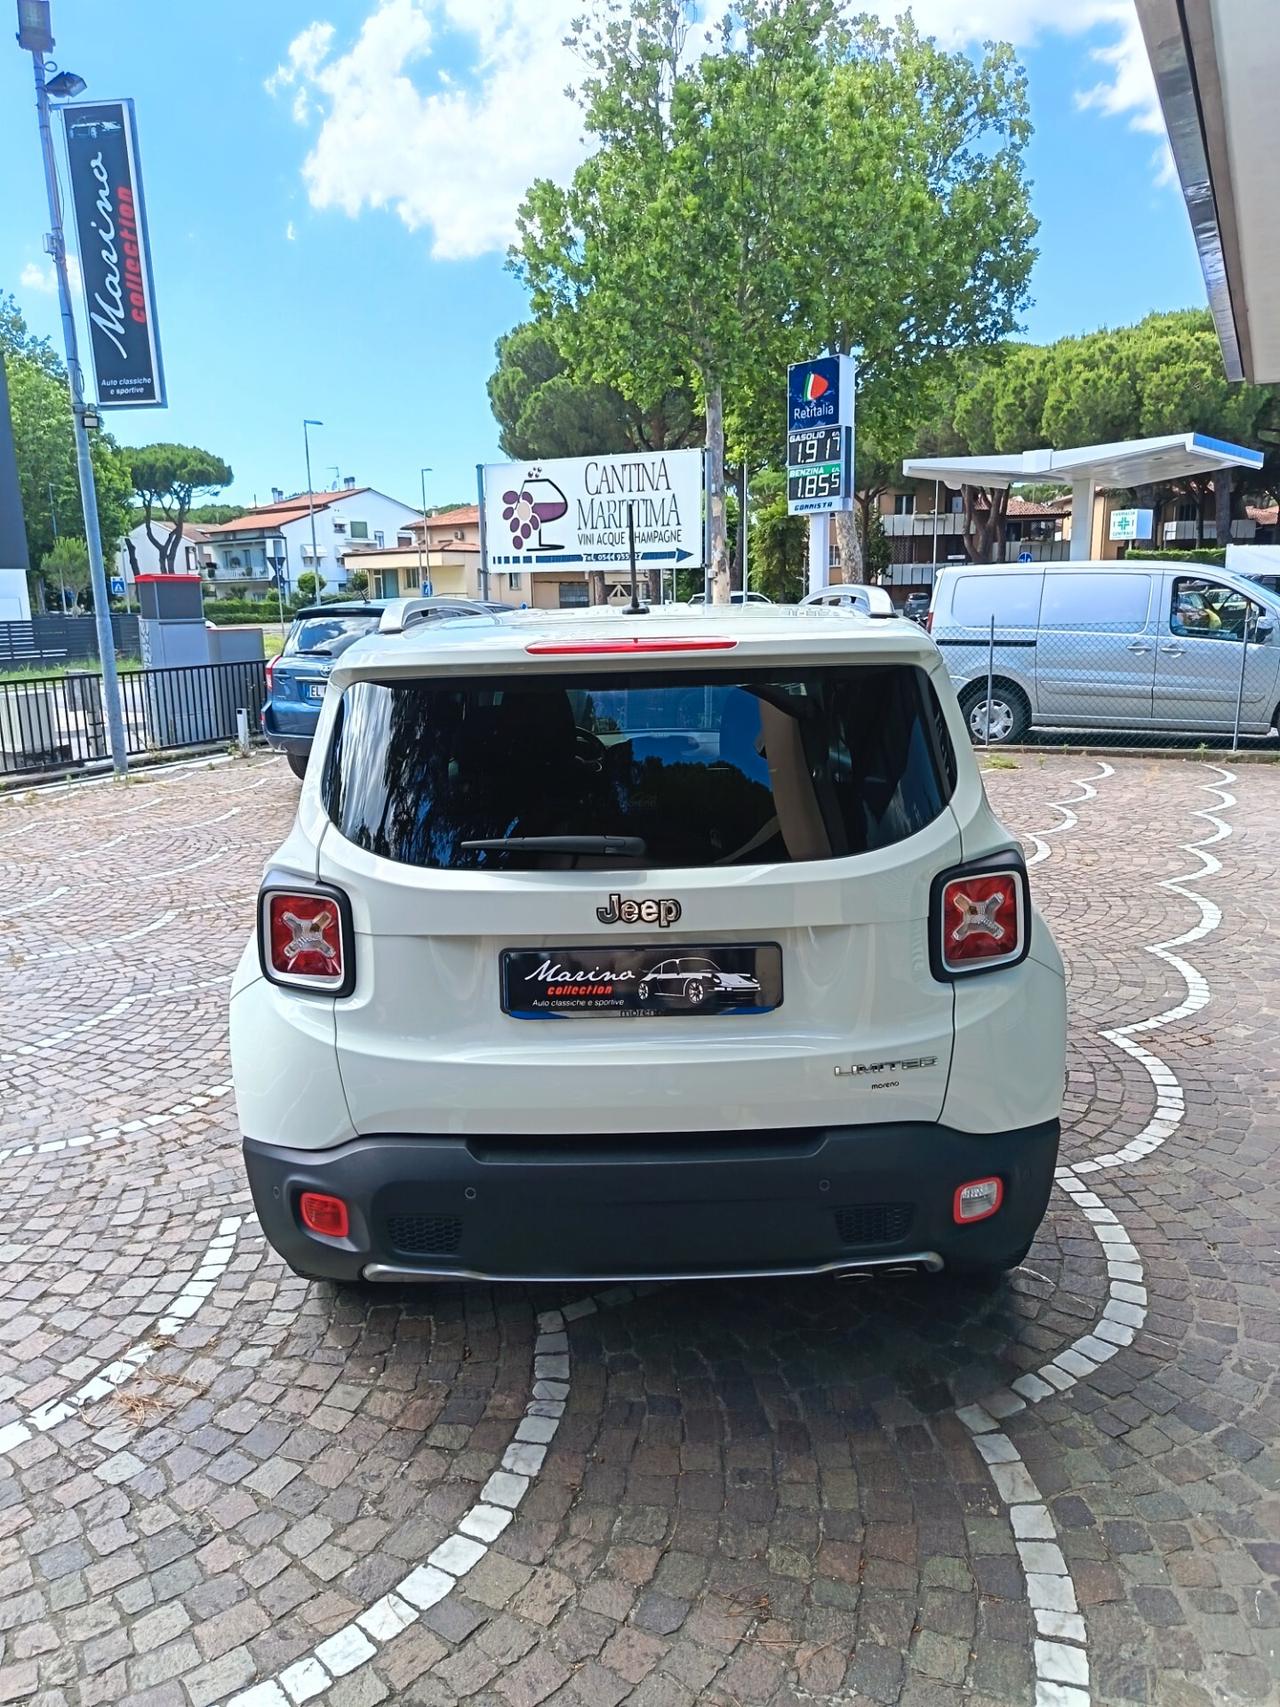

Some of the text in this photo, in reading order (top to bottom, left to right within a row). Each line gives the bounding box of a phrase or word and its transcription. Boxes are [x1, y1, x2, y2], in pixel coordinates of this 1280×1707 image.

[90, 152, 128, 359] Marino
[117, 186, 146, 323] collection
[116, 386, 144, 396] sportive
[793, 403, 834, 420] Retitalia
[789, 431, 825, 443] GASOLIO
[584, 457, 672, 496] CANTINA
[789, 466, 824, 478] BENZINA
[577, 529, 682, 547] VINI ACQUE HAMPAGNE
[311, 685, 326, 696] EL
[596, 894, 681, 928] Jeep
[524, 959, 636, 982] Marino
[546, 984, 613, 996] collection
[594, 999, 625, 1007] sportive
[834, 1056, 938, 1077] LIMITED
[871, 1080, 900, 1090] moreno
